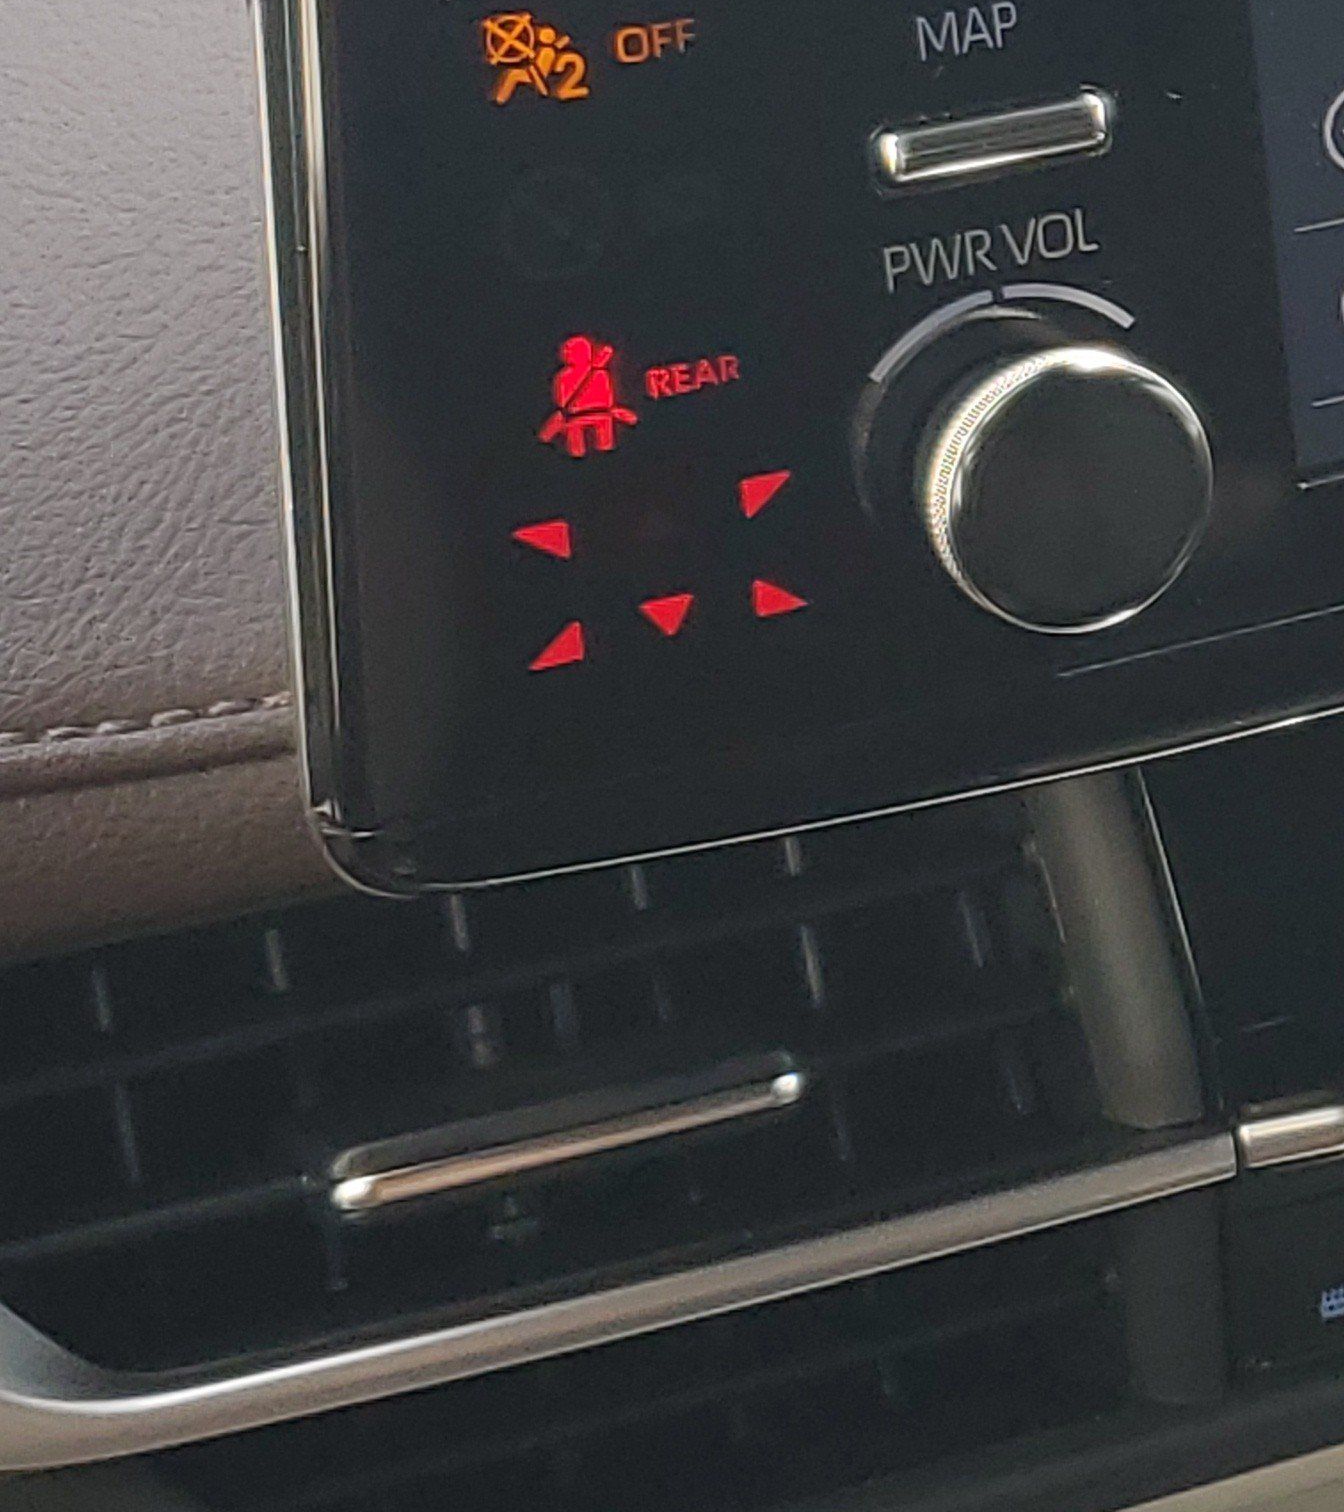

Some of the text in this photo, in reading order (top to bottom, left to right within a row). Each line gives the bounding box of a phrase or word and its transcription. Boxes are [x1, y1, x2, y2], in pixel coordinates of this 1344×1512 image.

[614, 17, 695, 64] OFF
[915, 1, 1017, 62] MAP
[883, 208, 1099, 292] PWR VOL
[645, 355, 740, 400] REAR
